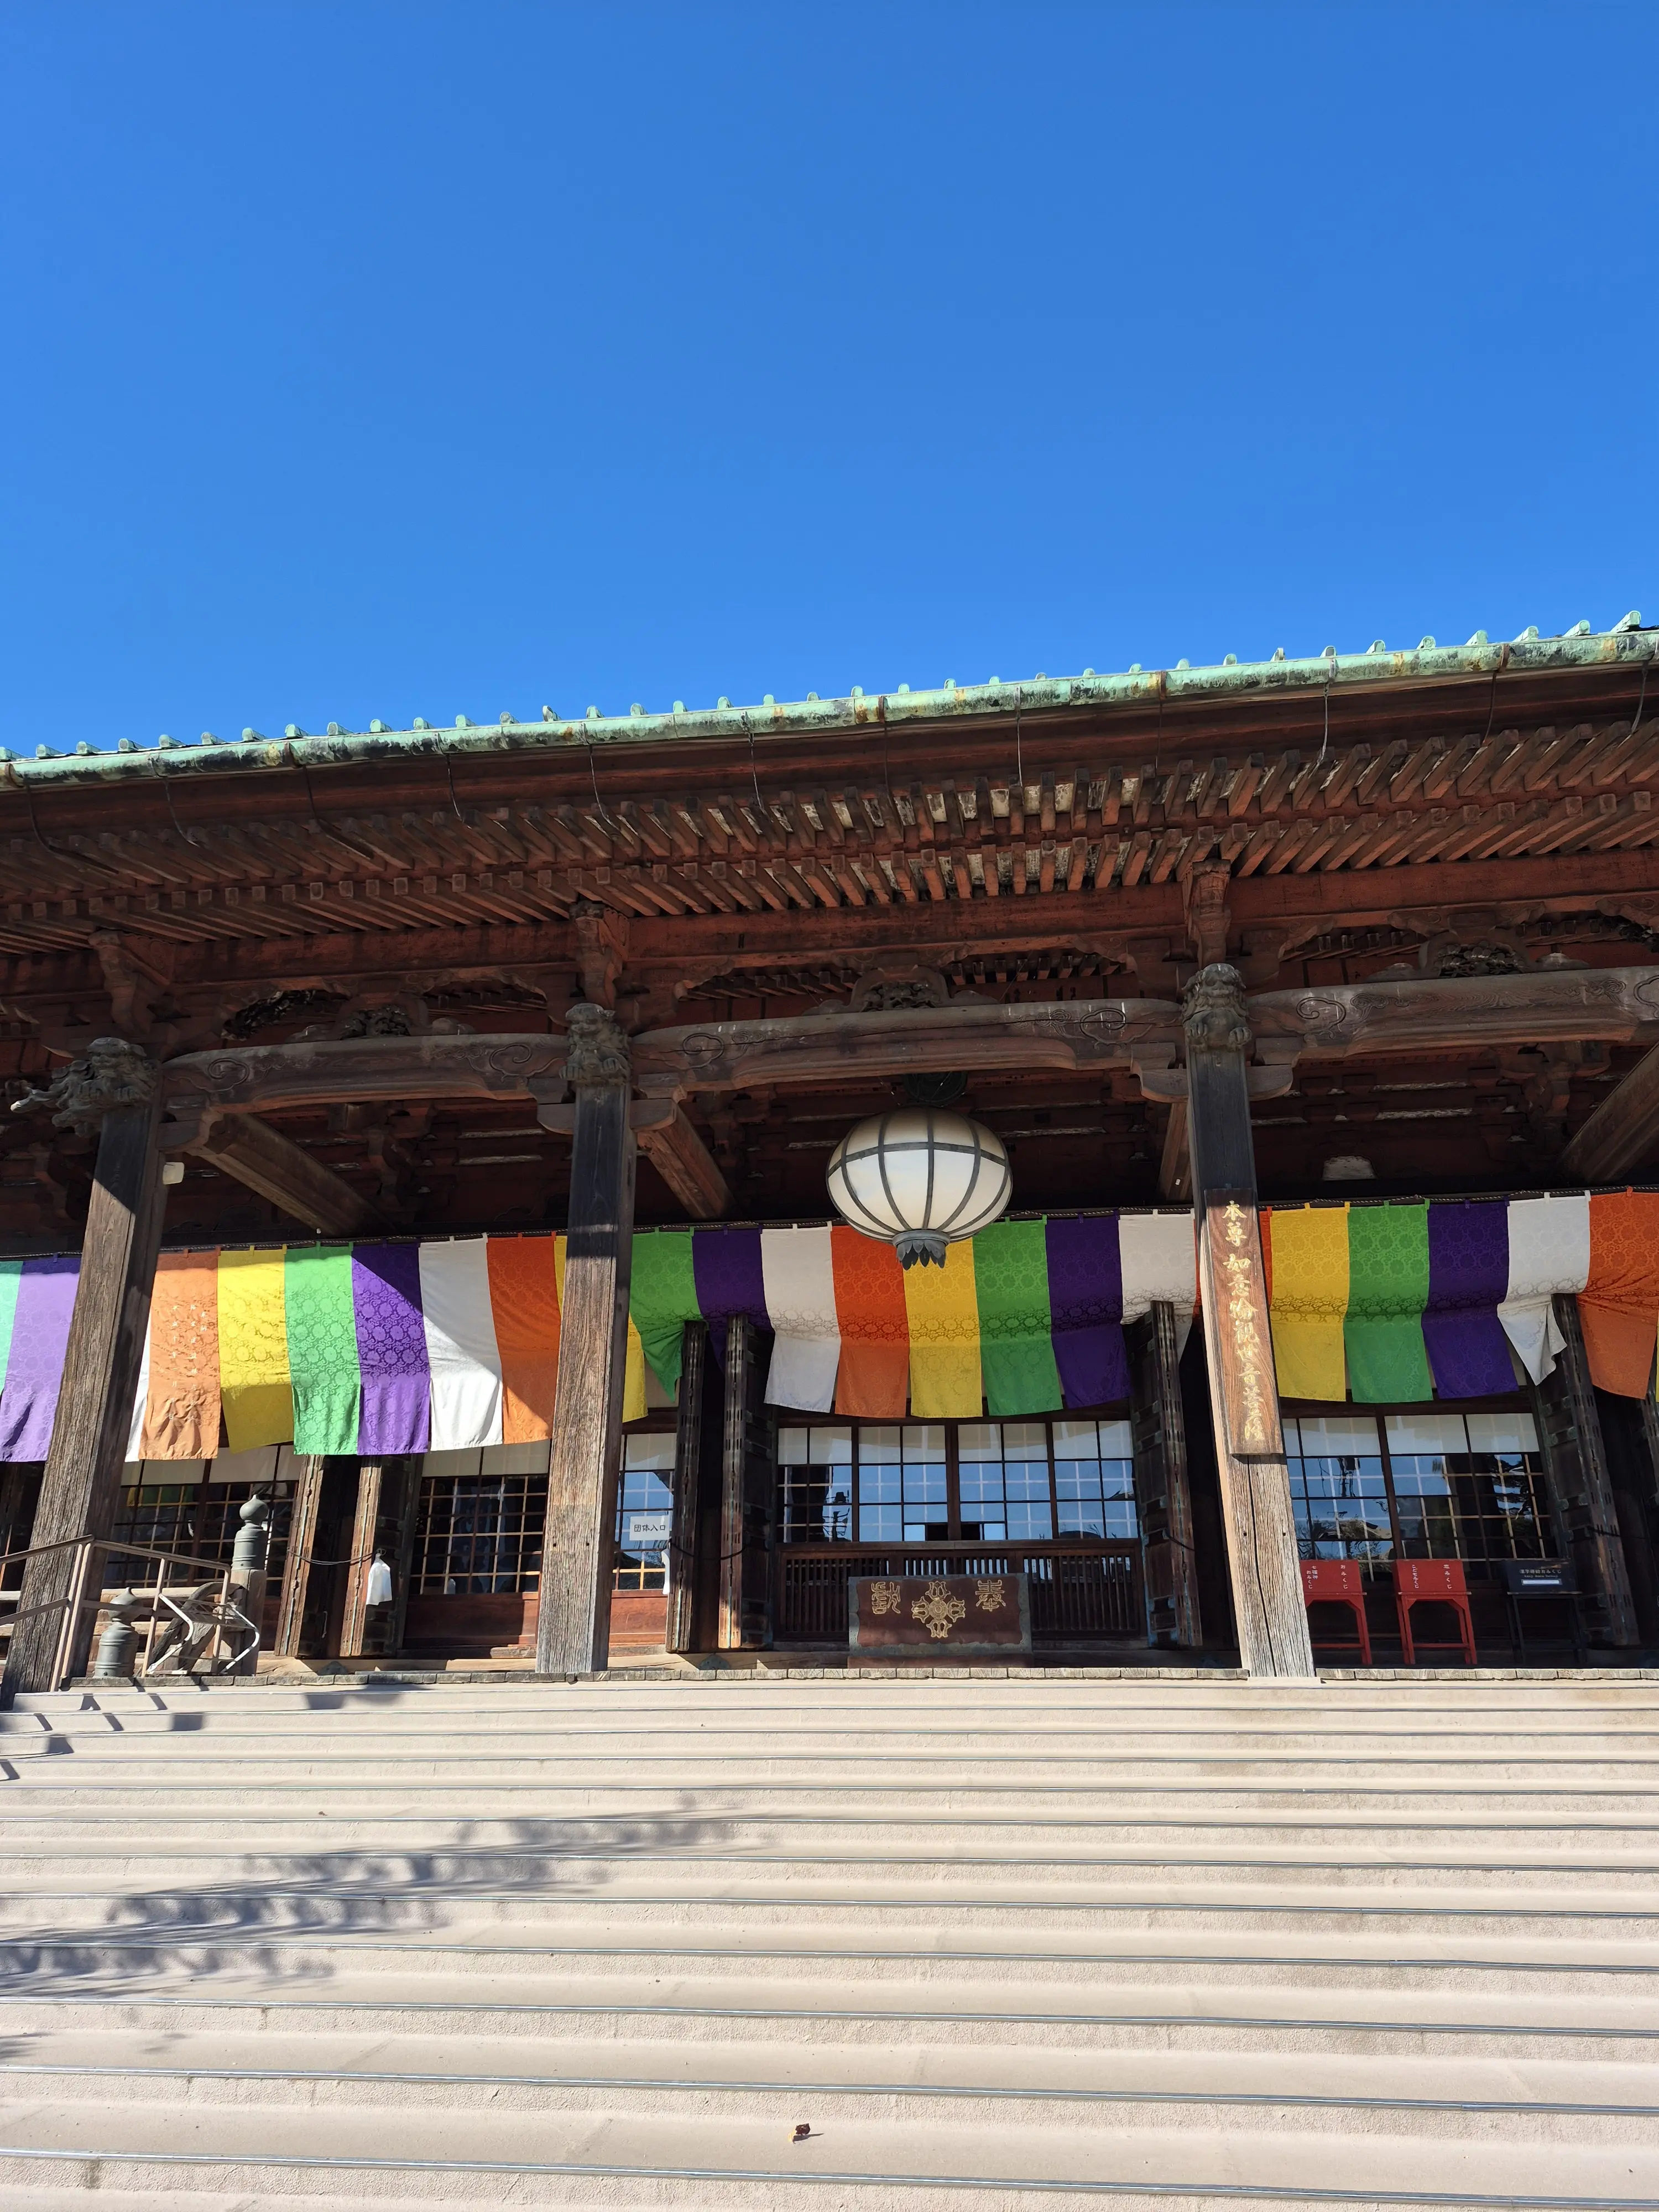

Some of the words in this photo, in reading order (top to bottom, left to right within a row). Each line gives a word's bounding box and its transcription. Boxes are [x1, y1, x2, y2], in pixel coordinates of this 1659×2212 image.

[634, 1524, 666, 1532] 団体入口
[1340, 1564, 1348, 1589] おみくじ
